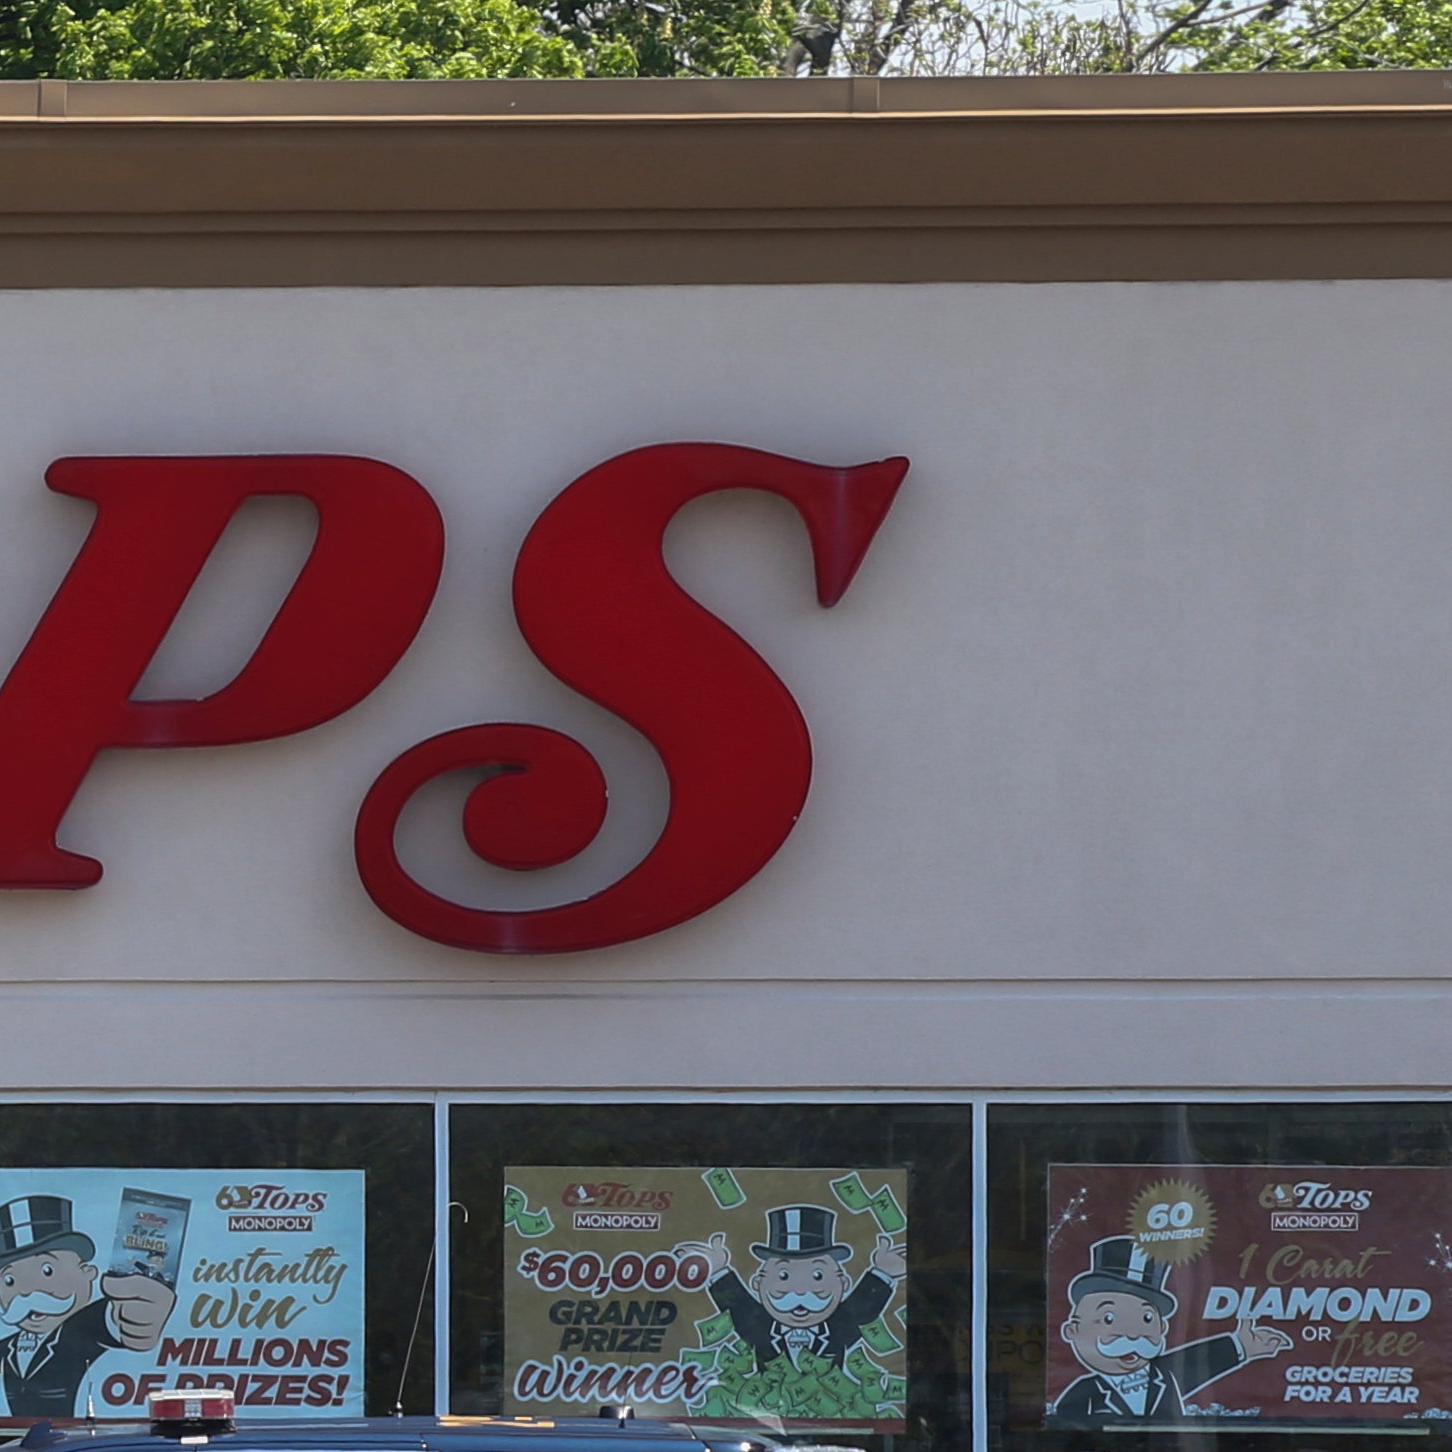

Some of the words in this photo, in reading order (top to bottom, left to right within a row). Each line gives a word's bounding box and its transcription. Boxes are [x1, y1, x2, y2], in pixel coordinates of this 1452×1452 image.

[230, 1217, 311, 1230] MONOPOLY
[577, 1215, 657, 1228] MONOPOLY
[1147, 1201, 1193, 1230] 60
[1274, 1216, 1355, 1228] MONOPOLY
[1139, 1227, 1205, 1242] WINNERS!
[192, 1246, 349, 1304] instantly
[520, 1250, 710, 1295] $60,000
[1239, 1242, 1260, 1280] 1
[1266, 1244, 1392, 1285] Carat
[549, 1300, 677, 1326] GRAND
[1202, 1286, 1432, 1322] DIAMOND
[559, 1327, 667, 1352] PRIZE
[1302, 1325, 1331, 1342] OR
[156, 1338, 350, 1367] MILLIONS
[1285, 1366, 1414, 1384] GROCERIES
[101, 1373, 167, 1406] OF
[1284, 1385, 1330, 1403] FOR
[1333, 1387, 1354, 1403] A
[1359, 1386, 1420, 1404] YEAR
